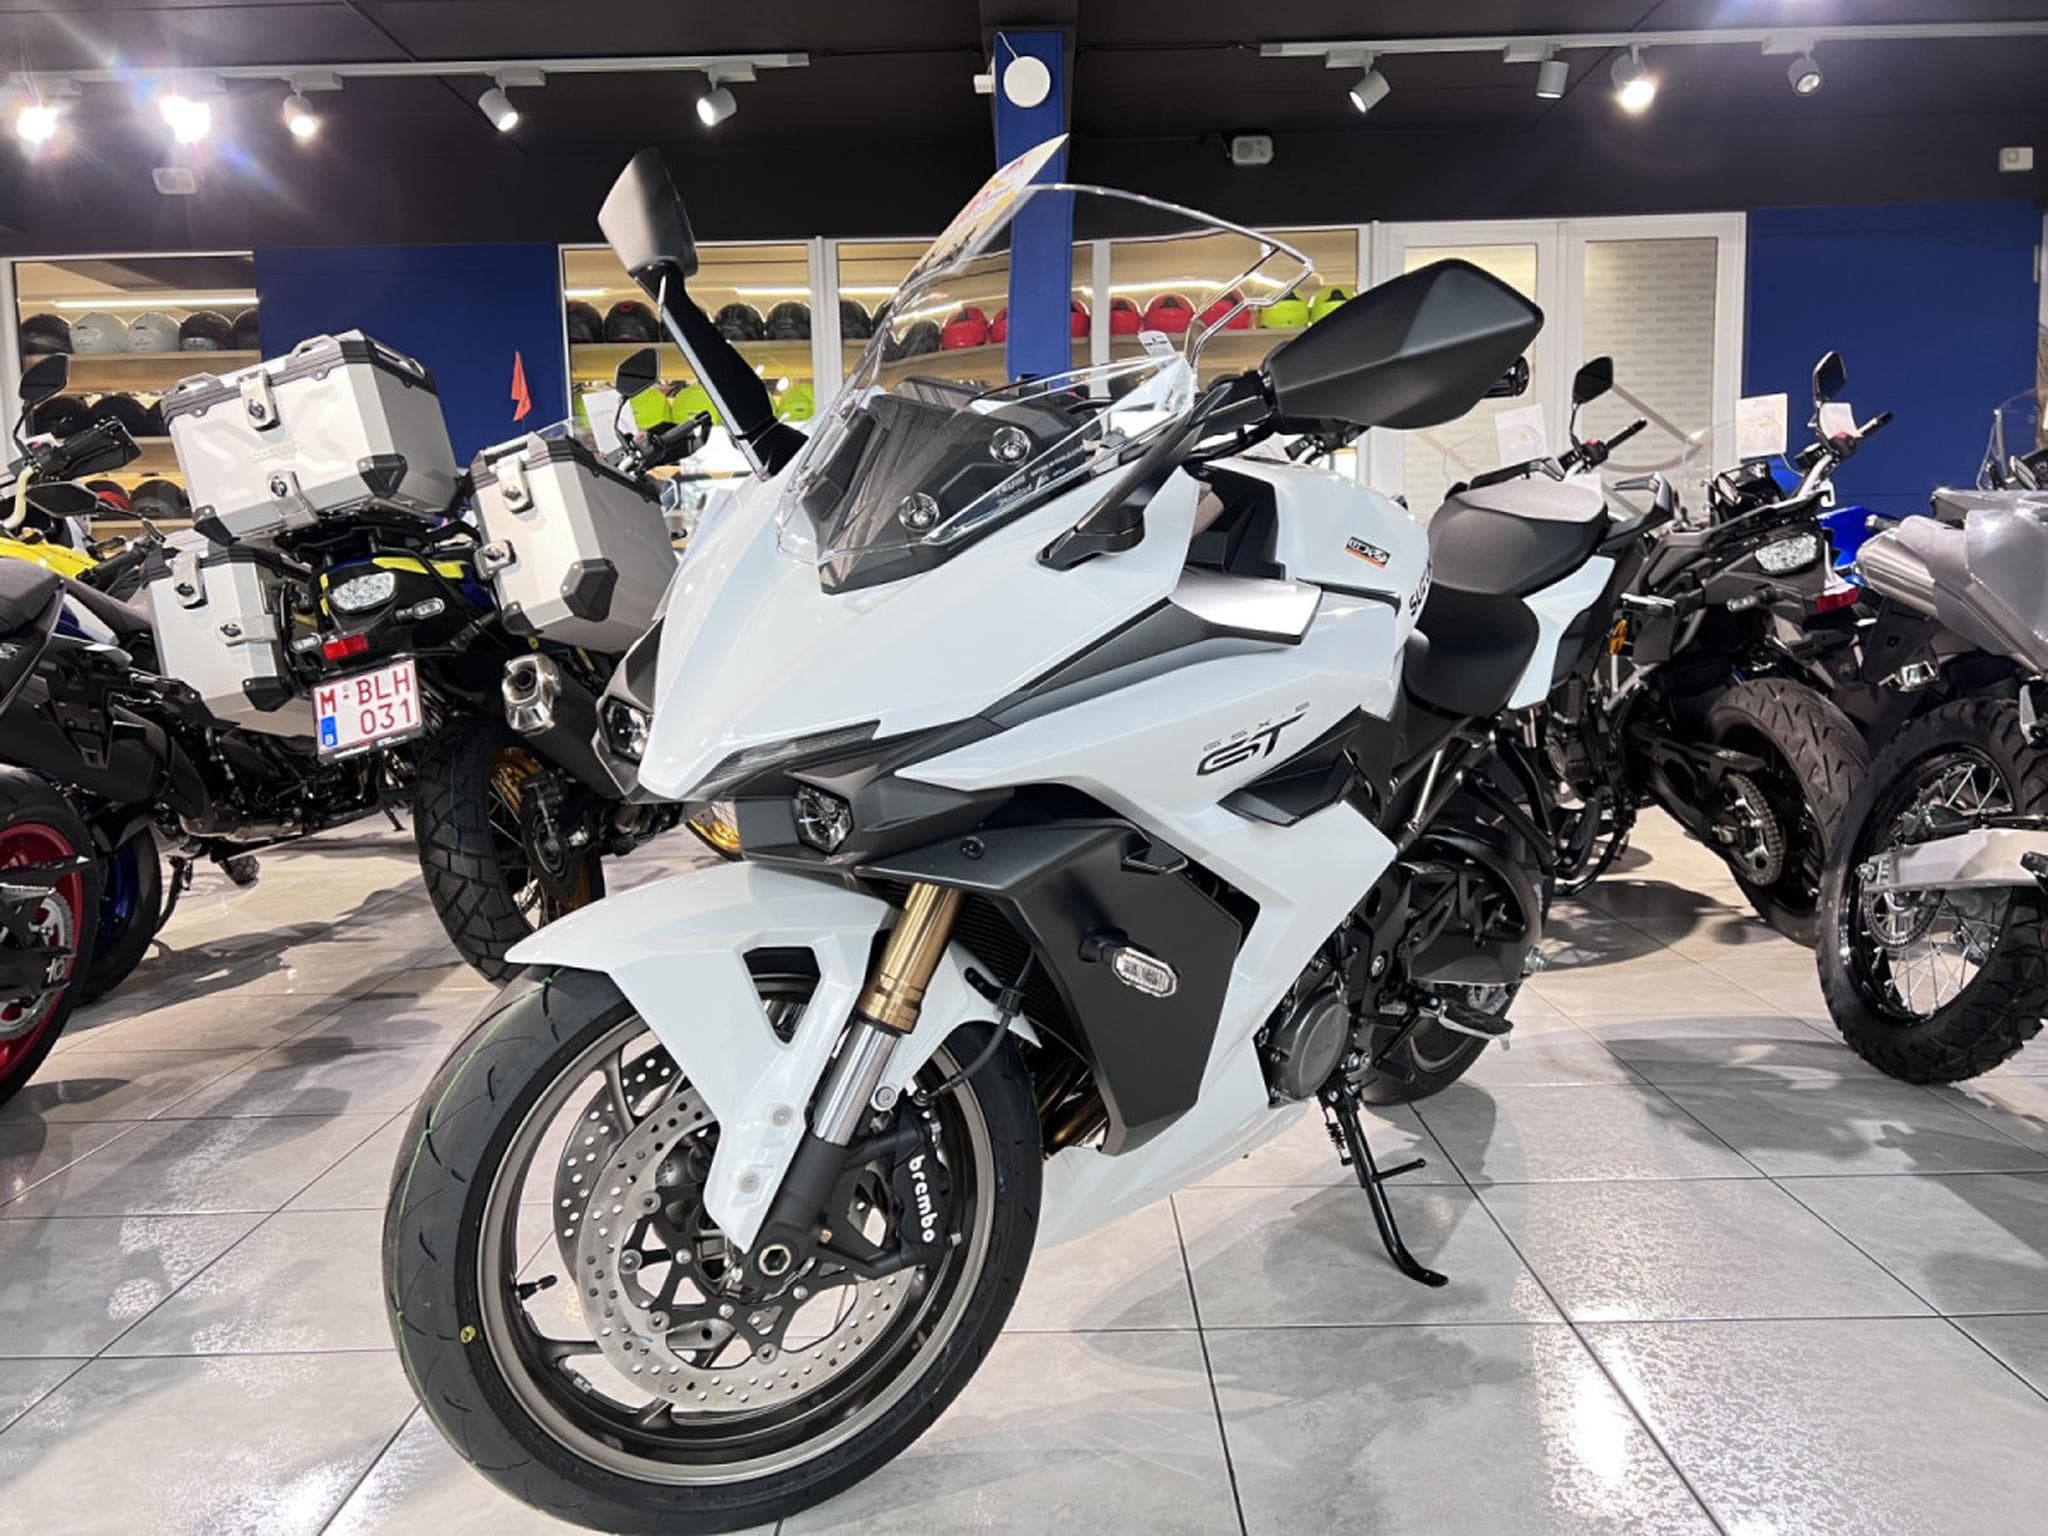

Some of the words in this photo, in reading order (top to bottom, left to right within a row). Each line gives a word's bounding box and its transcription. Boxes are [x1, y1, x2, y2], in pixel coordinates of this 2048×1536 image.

[360, 698, 411, 735] 031
[1197, 711, 1307, 776] GT
[908, 1154, 938, 1243] brembo
